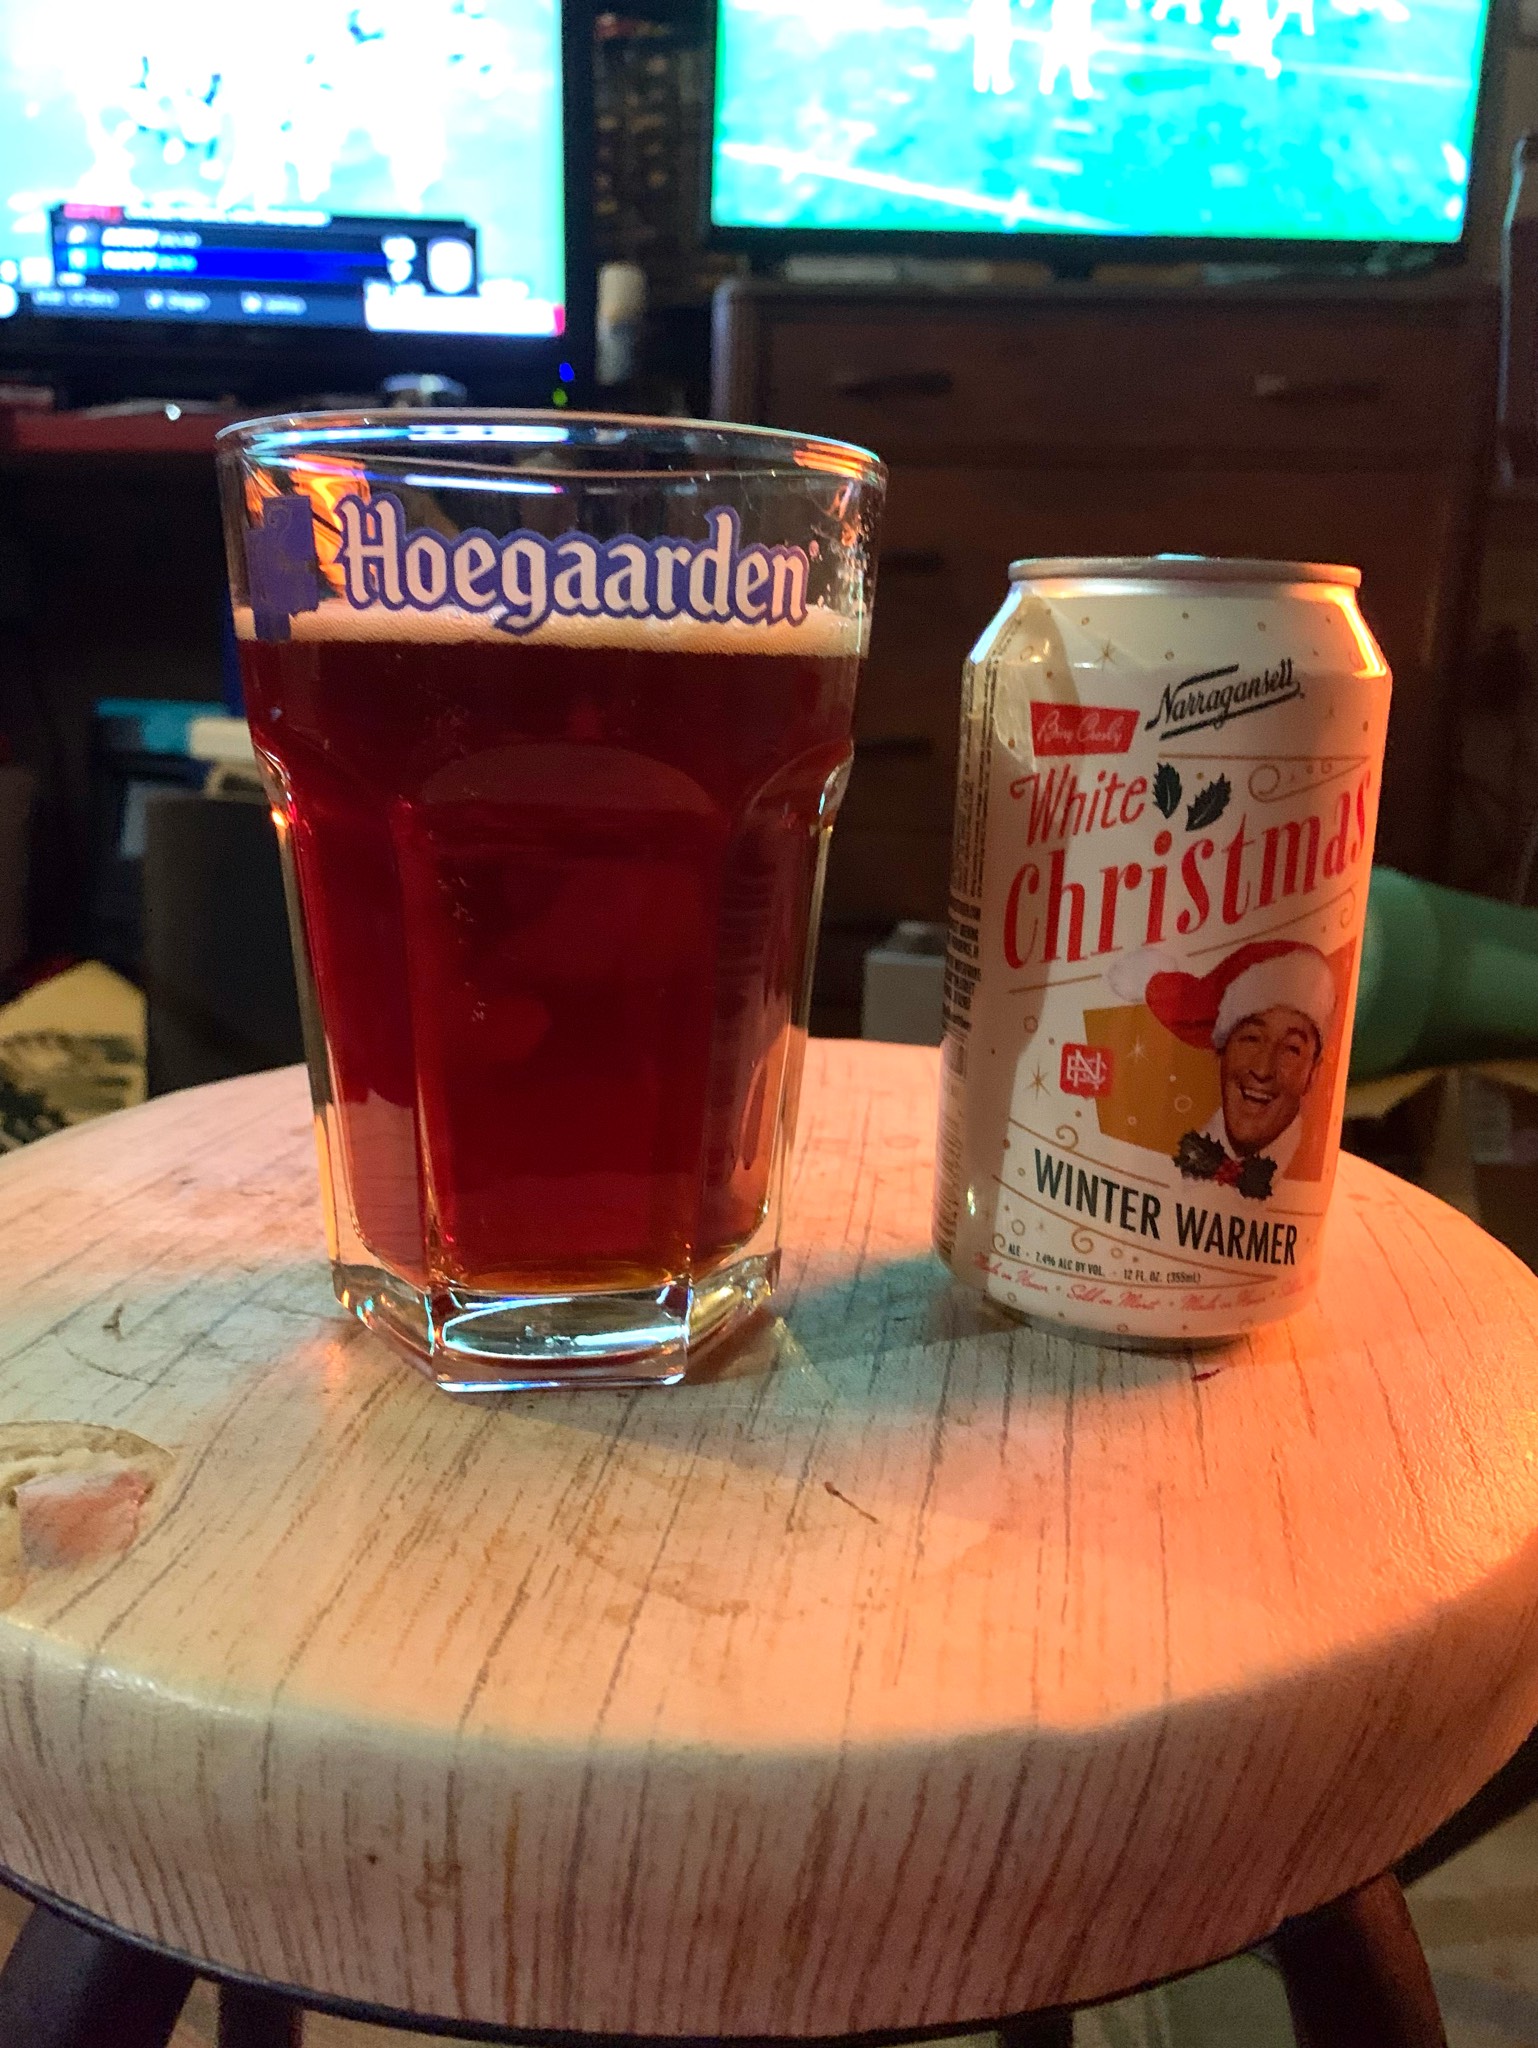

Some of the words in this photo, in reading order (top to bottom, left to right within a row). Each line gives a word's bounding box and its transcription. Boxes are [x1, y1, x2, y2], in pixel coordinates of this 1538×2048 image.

[338, 497, 808, 631] Hoegaarden
[1145, 657, 1301, 732] Narragansett
[1010, 763, 1148, 847] White
[1003, 770, 1372, 969] Christmas
[1034, 1148, 1162, 1241] WINTER
[1175, 1202, 1298, 1265] WARMER
[1058, 1257, 1073, 1271] ALC
[1075, 1261, 1087, 1273] BY
[1123, 1268, 1133, 1280] 12
